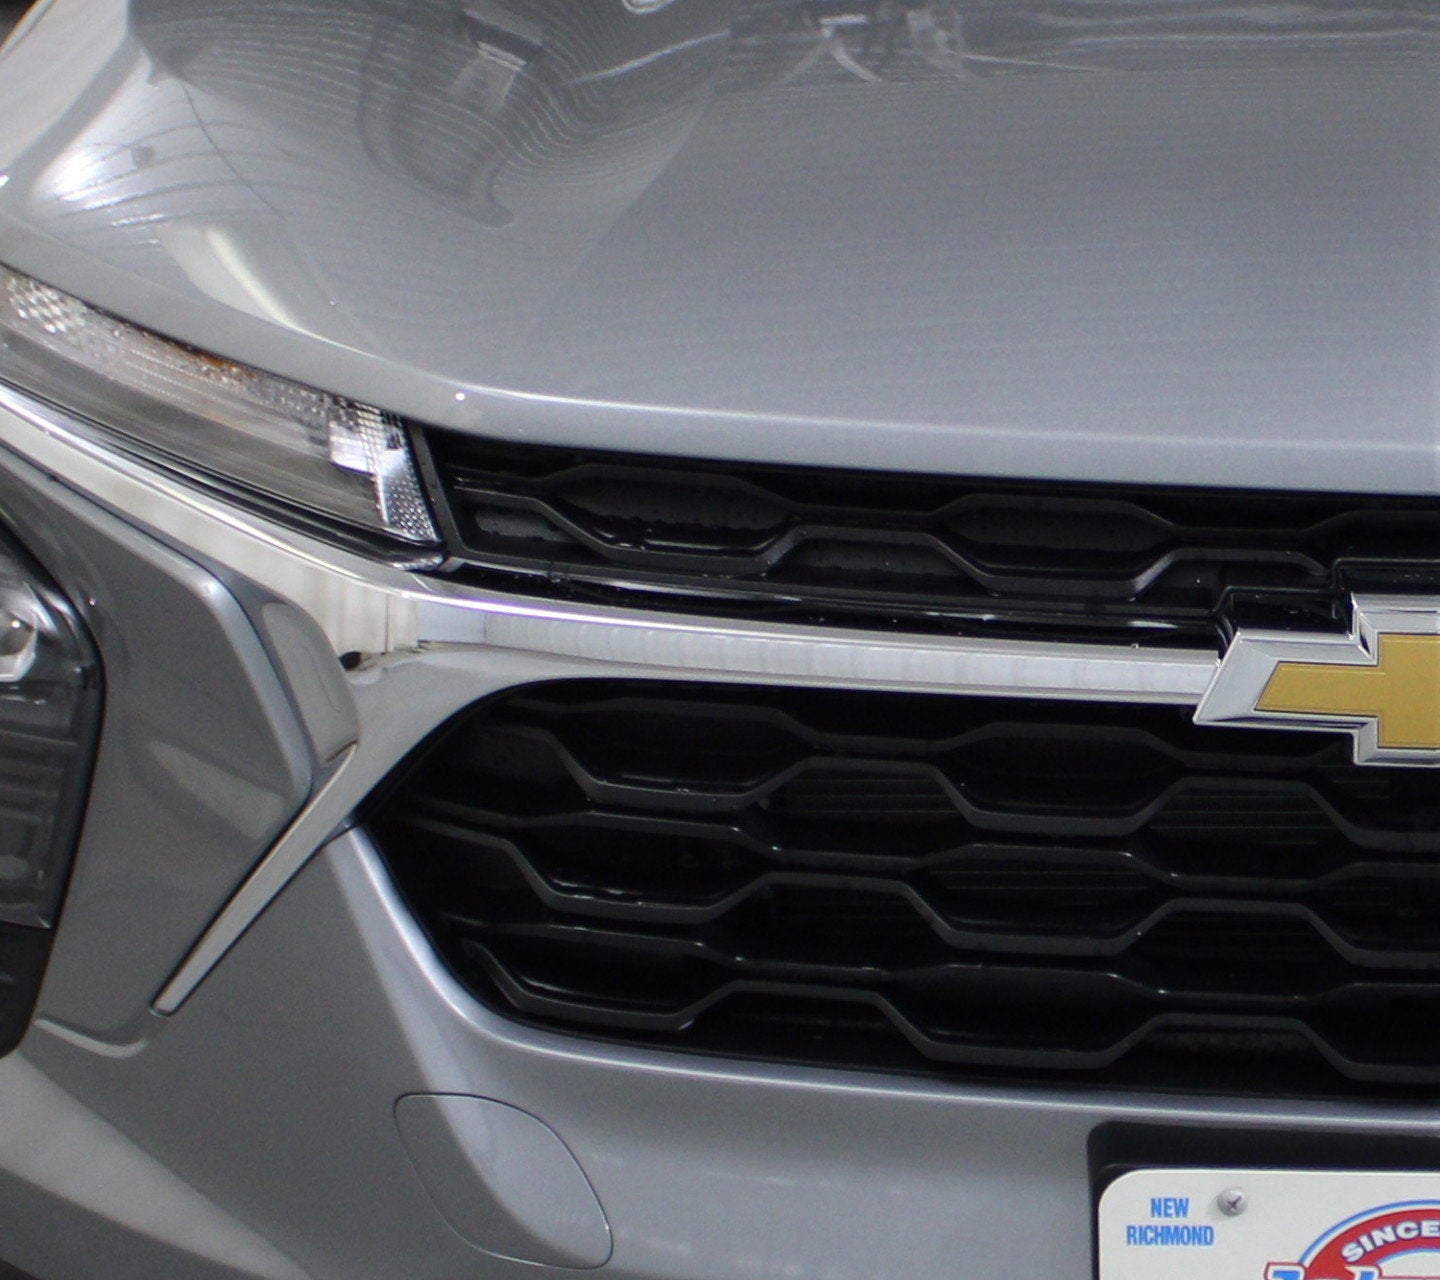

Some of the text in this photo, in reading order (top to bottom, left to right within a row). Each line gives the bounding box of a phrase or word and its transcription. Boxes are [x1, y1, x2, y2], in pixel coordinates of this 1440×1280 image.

[1150, 1197, 1190, 1218] NEW
[1126, 1225, 1215, 1246] RICHMOND
[1341, 1220, 1440, 1264] SINCE
